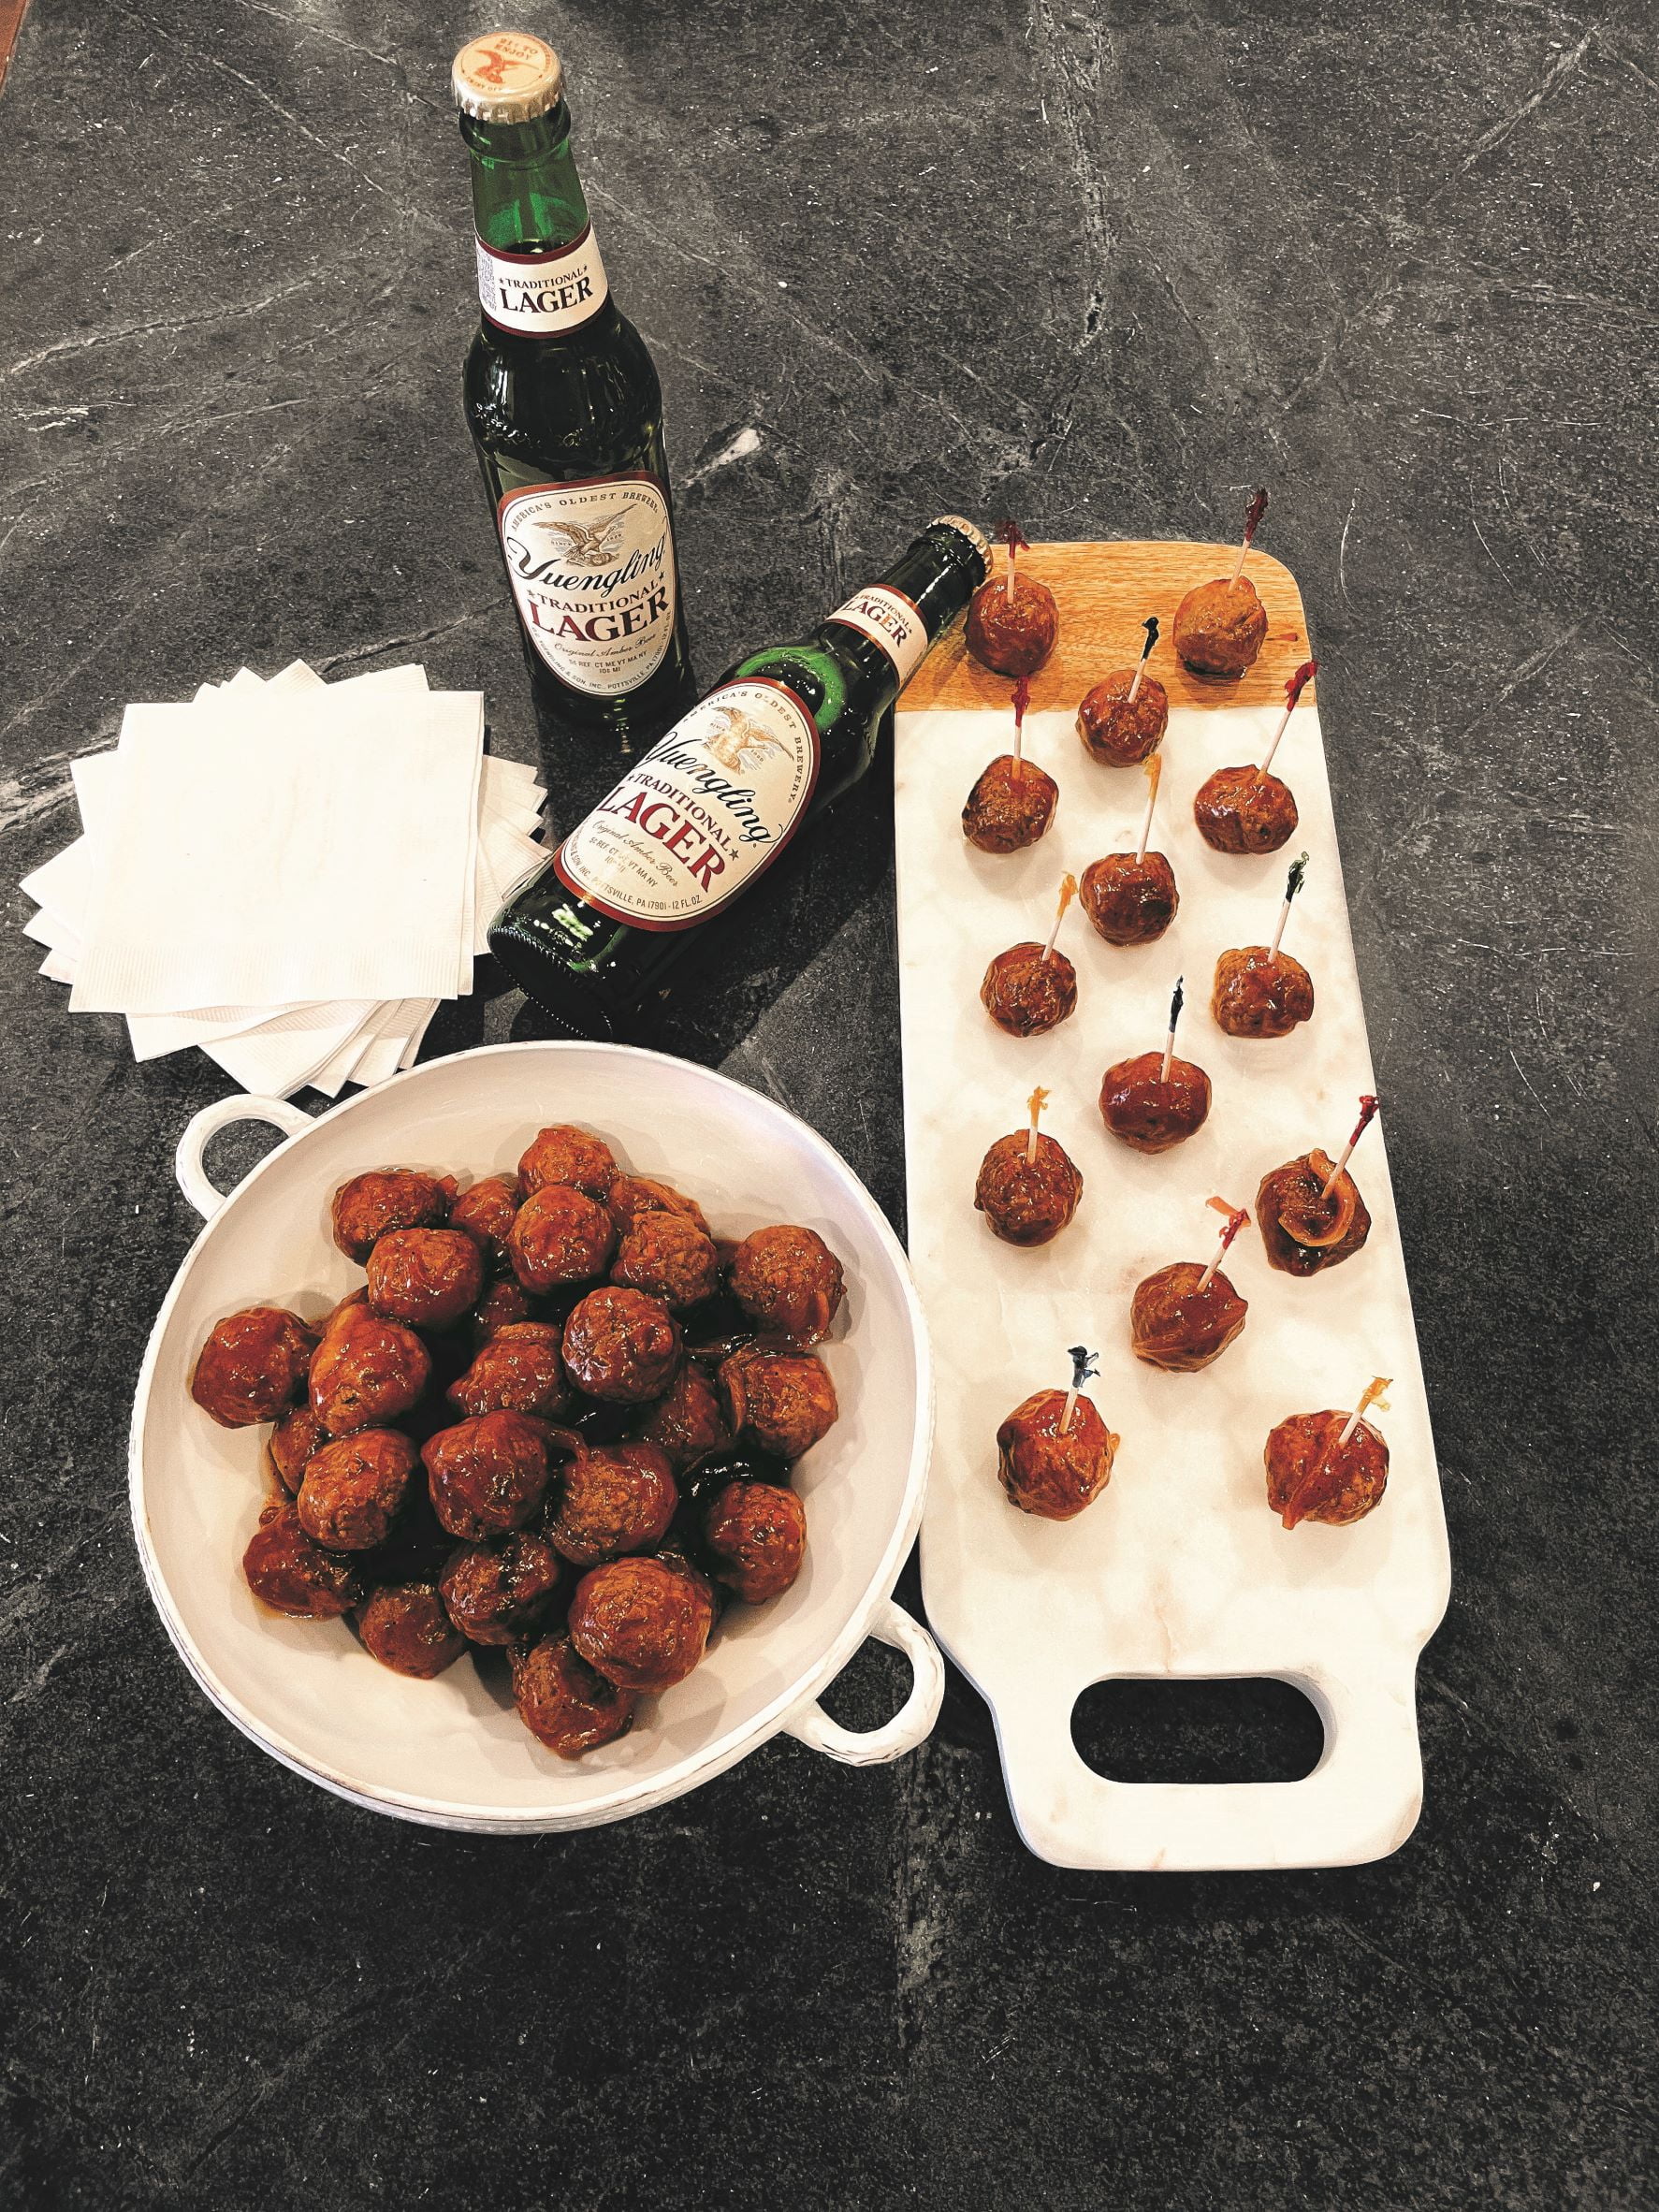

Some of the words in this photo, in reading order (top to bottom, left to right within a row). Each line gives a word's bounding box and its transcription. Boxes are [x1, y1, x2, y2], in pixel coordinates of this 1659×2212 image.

[499, 276, 593, 313] LAGER
[505, 268, 583, 289] TRADITIONAL
[511, 502, 552, 532] AMERICA'S
[559, 492, 617, 506] OLDEST
[506, 517, 668, 599] Yuengling
[527, 586, 670, 642] LAGER
[536, 579, 659, 614] TRADITIONAL
[858, 593, 910, 631] TRADITIONAL
[844, 600, 908, 648] LAGER
[554, 643, 597, 657] Original
[617, 658, 626, 666] VT
[628, 655, 638, 663] MA
[633, 731, 784, 844] Yuengling
[633, 773, 731, 851] TRADITIONAL
[597, 786, 726, 893] LAGER
[608, 847, 619, 855] CT
[628, 860, 639, 869] VT
[635, 867, 648, 880] MA
[646, 877, 659, 888] NY
[623, 838, 657, 865] Amber
[655, 862, 679, 887] Beer
[591, 876, 634, 906] PTSVILLE,
[636, 897, 647, 908] PA
[648, 900, 667, 910] 17901
[672, 900, 680, 910] 12
